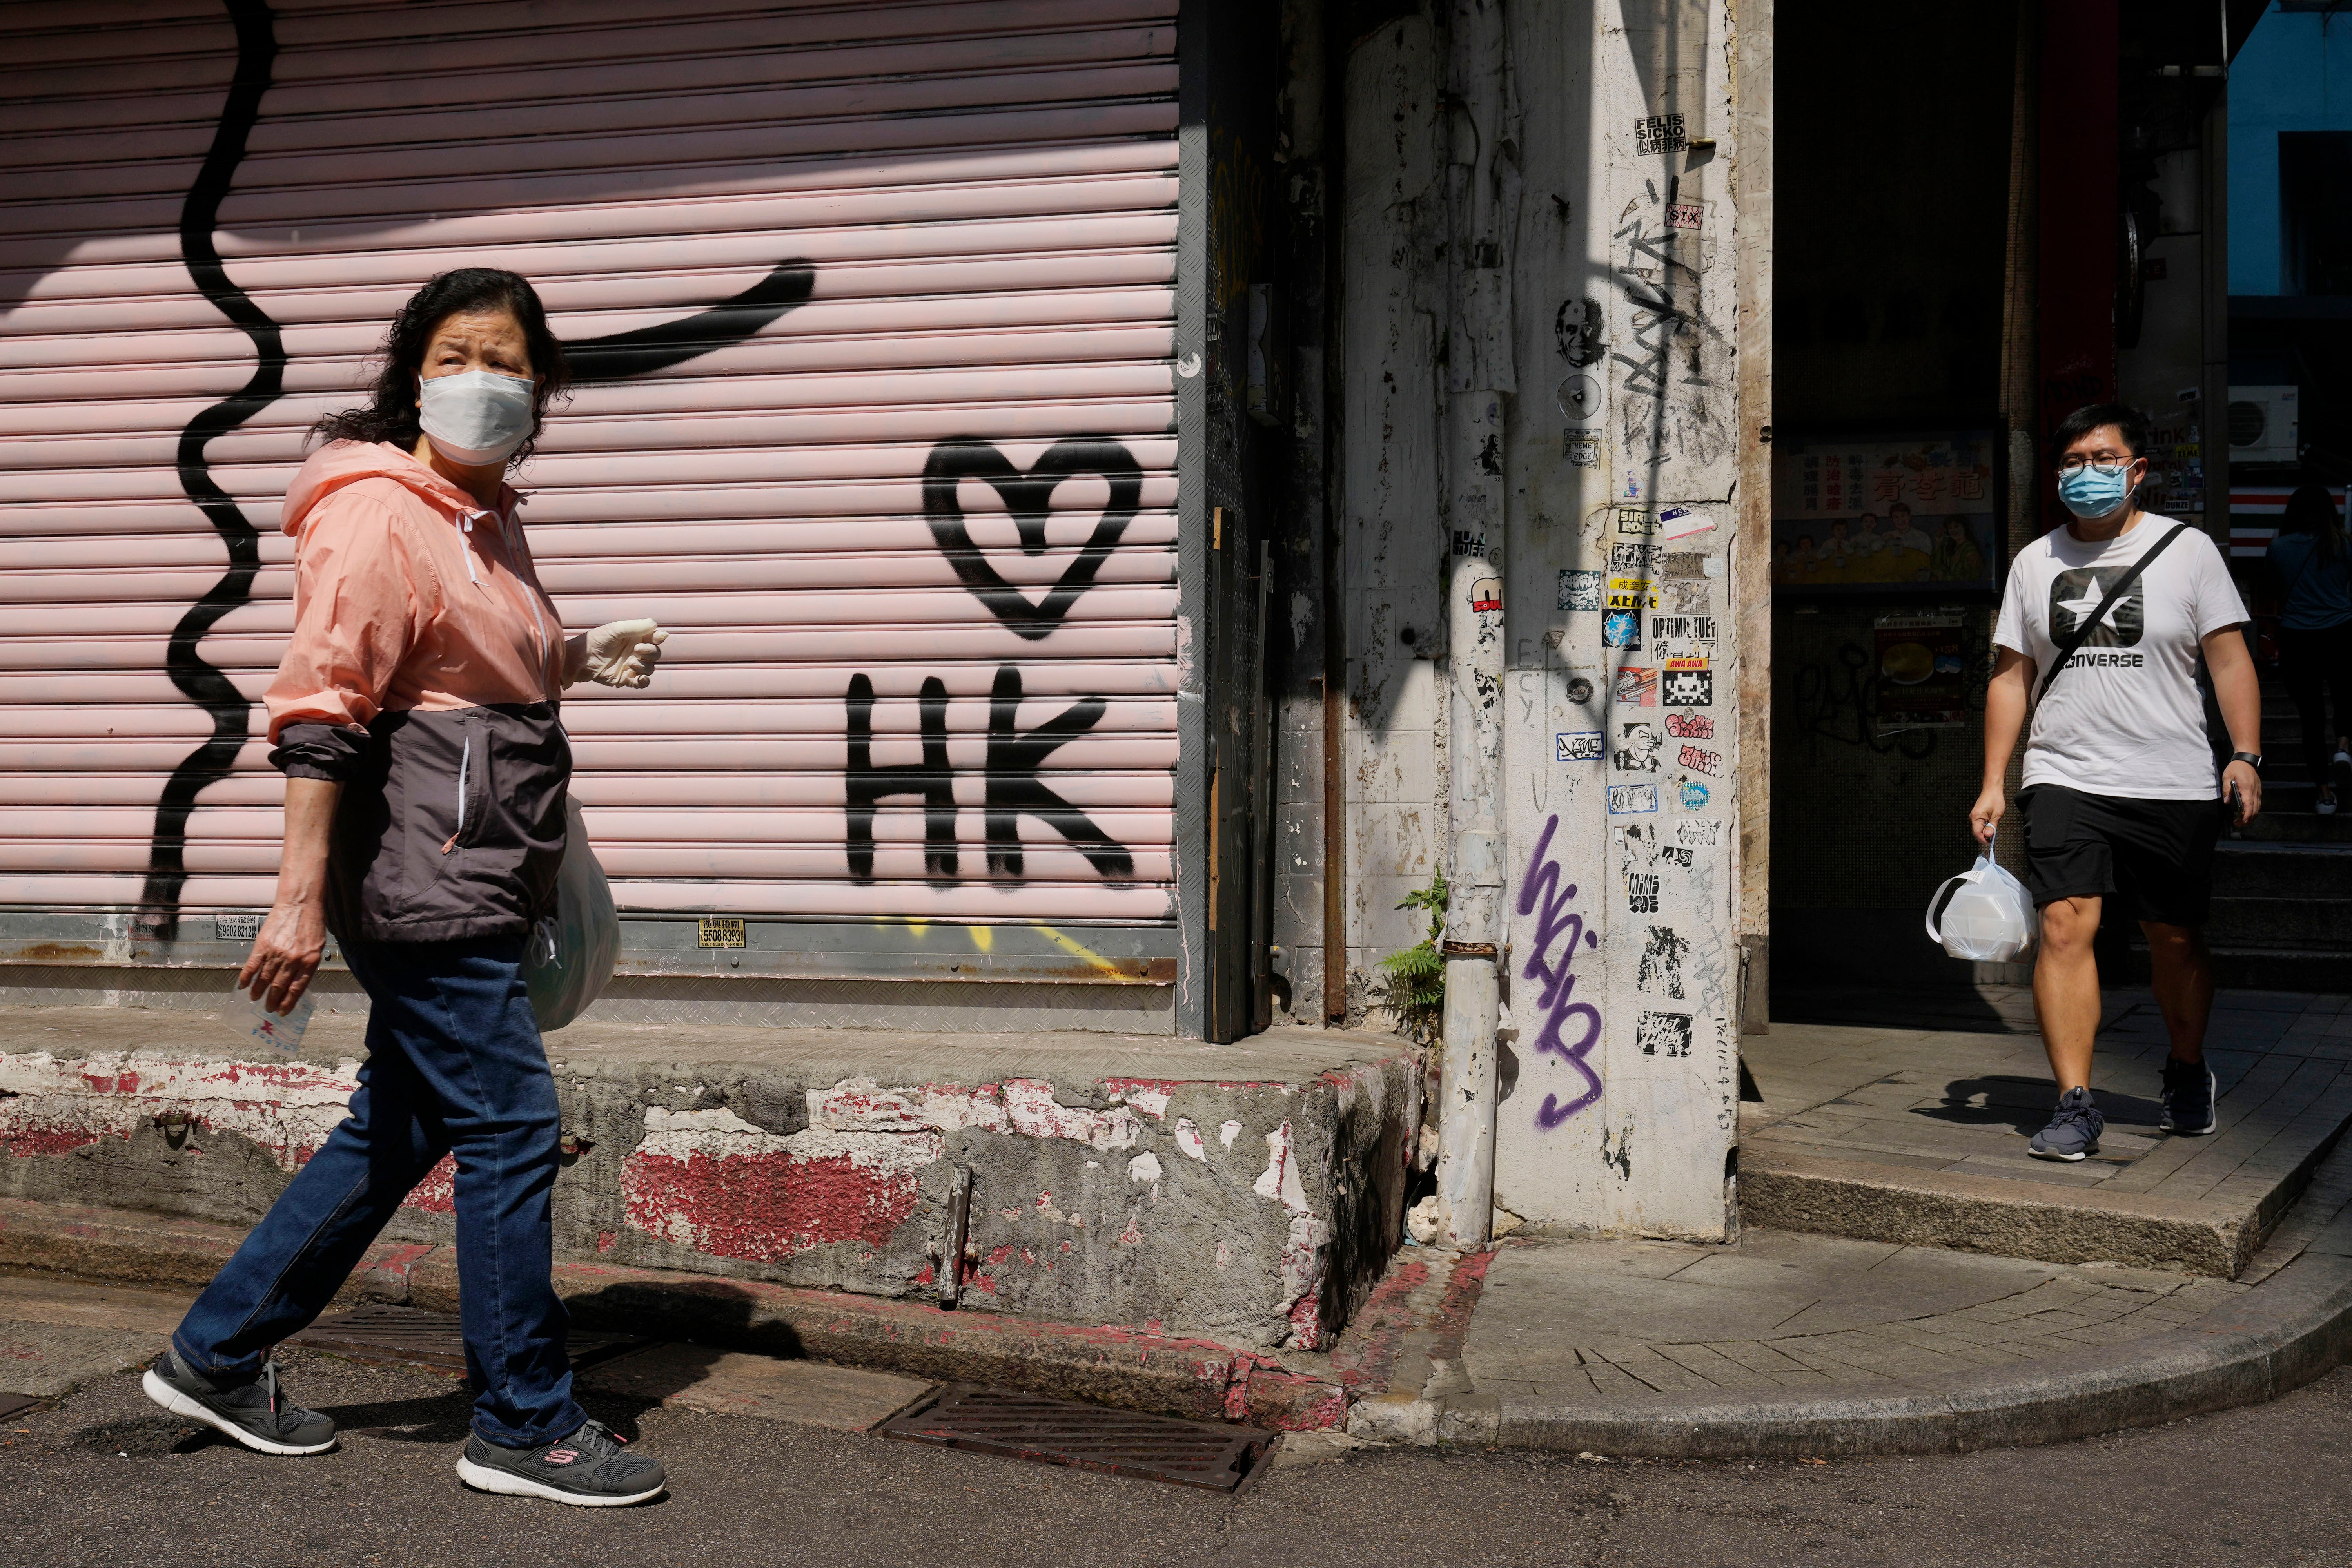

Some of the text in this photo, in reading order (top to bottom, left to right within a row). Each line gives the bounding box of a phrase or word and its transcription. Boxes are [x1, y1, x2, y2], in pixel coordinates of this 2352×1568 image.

[1637, 116, 1683, 129] FELIS
[1637, 126, 1684, 139] SICKO
[1671, 210, 1697, 223] SIX
[1473, 600, 1502, 612] SOUL
[2063, 654, 2143, 670] ONVERSE
[846, 666, 1136, 886] HK
[223, 924, 251, 937] 9602 8212
[704, 929, 740, 942] 5508 8393
